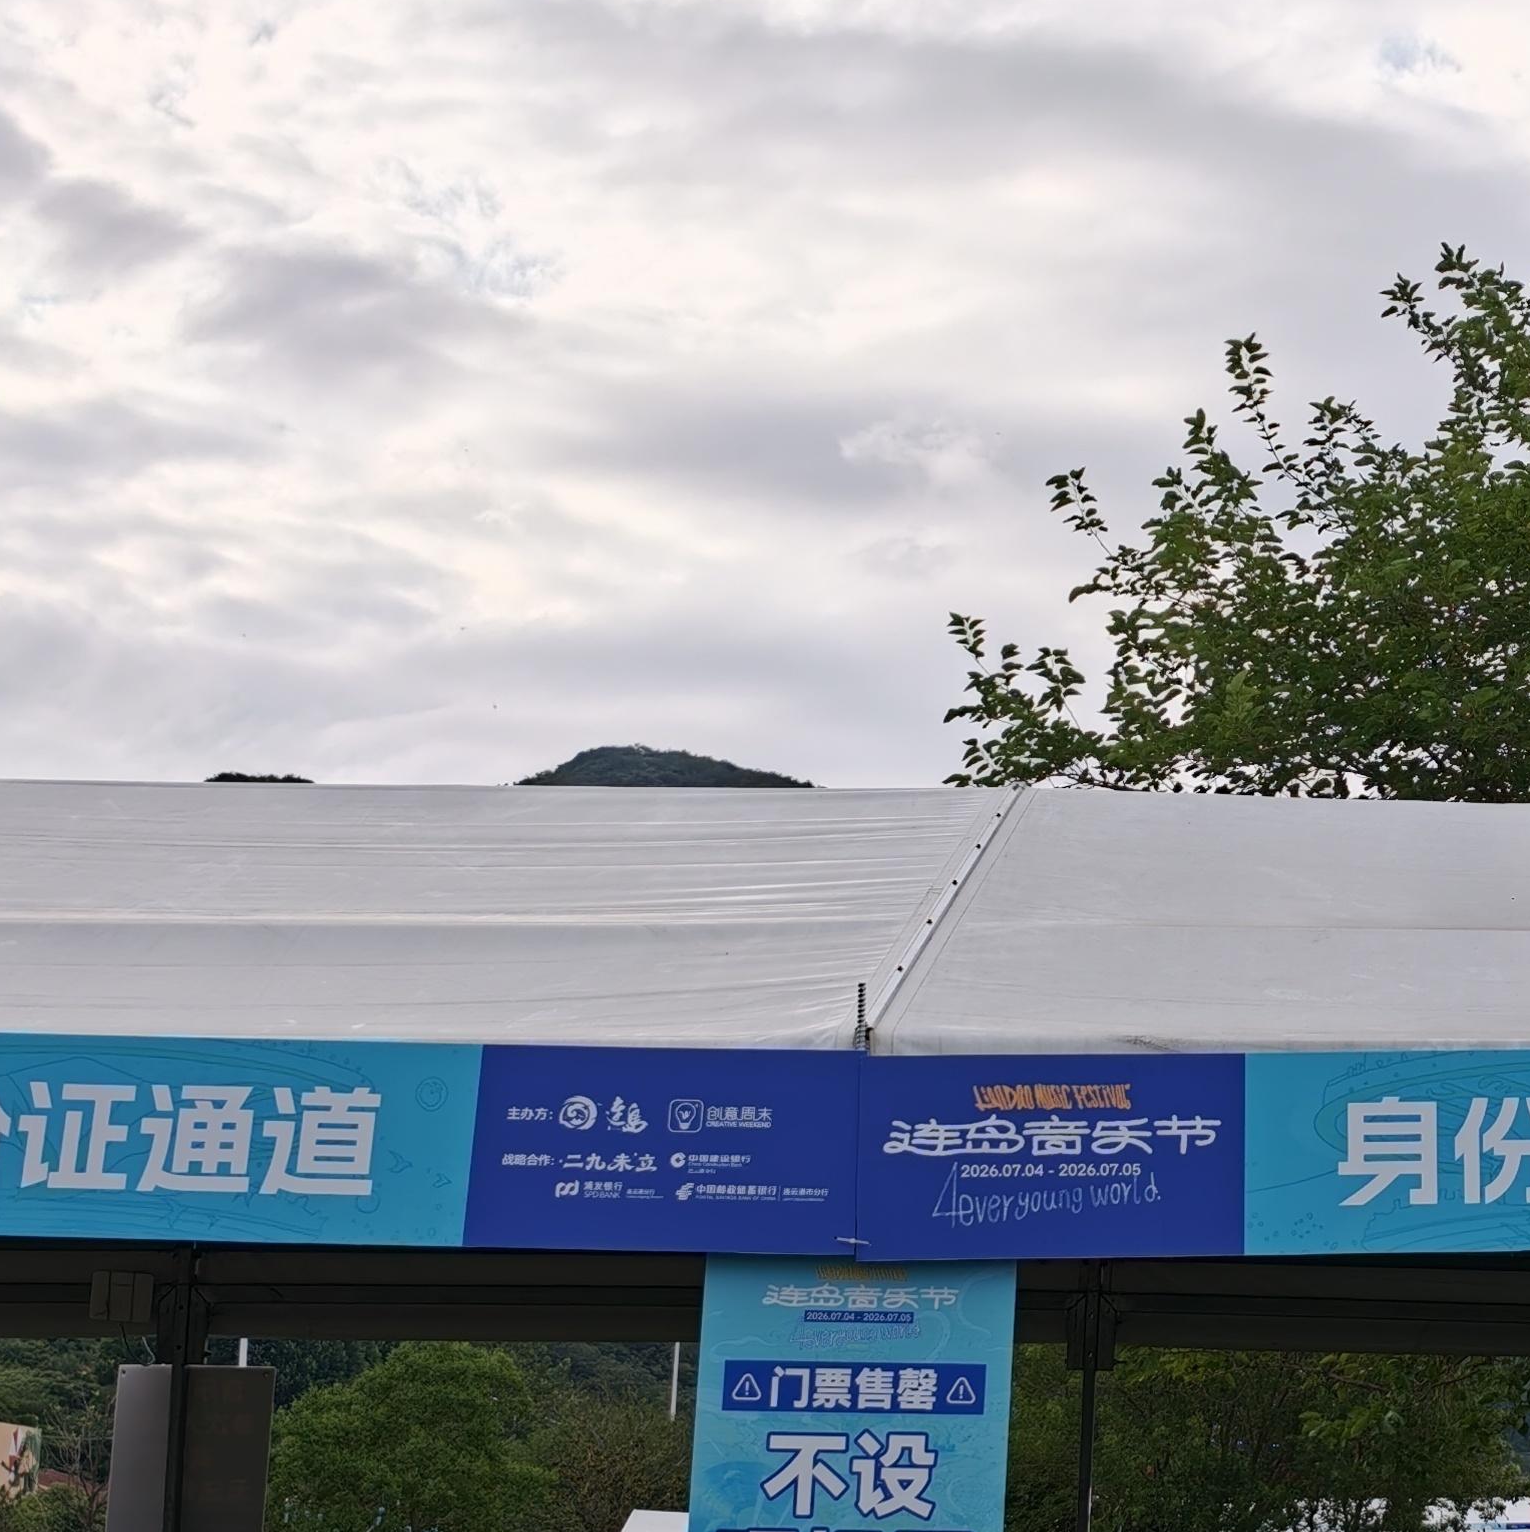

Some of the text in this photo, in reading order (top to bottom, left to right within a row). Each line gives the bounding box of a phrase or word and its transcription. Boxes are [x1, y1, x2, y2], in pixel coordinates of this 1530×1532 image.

[706, 1107, 772, 1121] 创意周末
[883, 1115, 1221, 1156] 连岛音乐节
[960, 1165, 1043, 1178] 2026.07.04
[1059, 1164, 1141, 1177] 2026.07.05
[770, 1366, 938, 1410] 门票售罄
[763, 1431, 940, 1520] 不设
